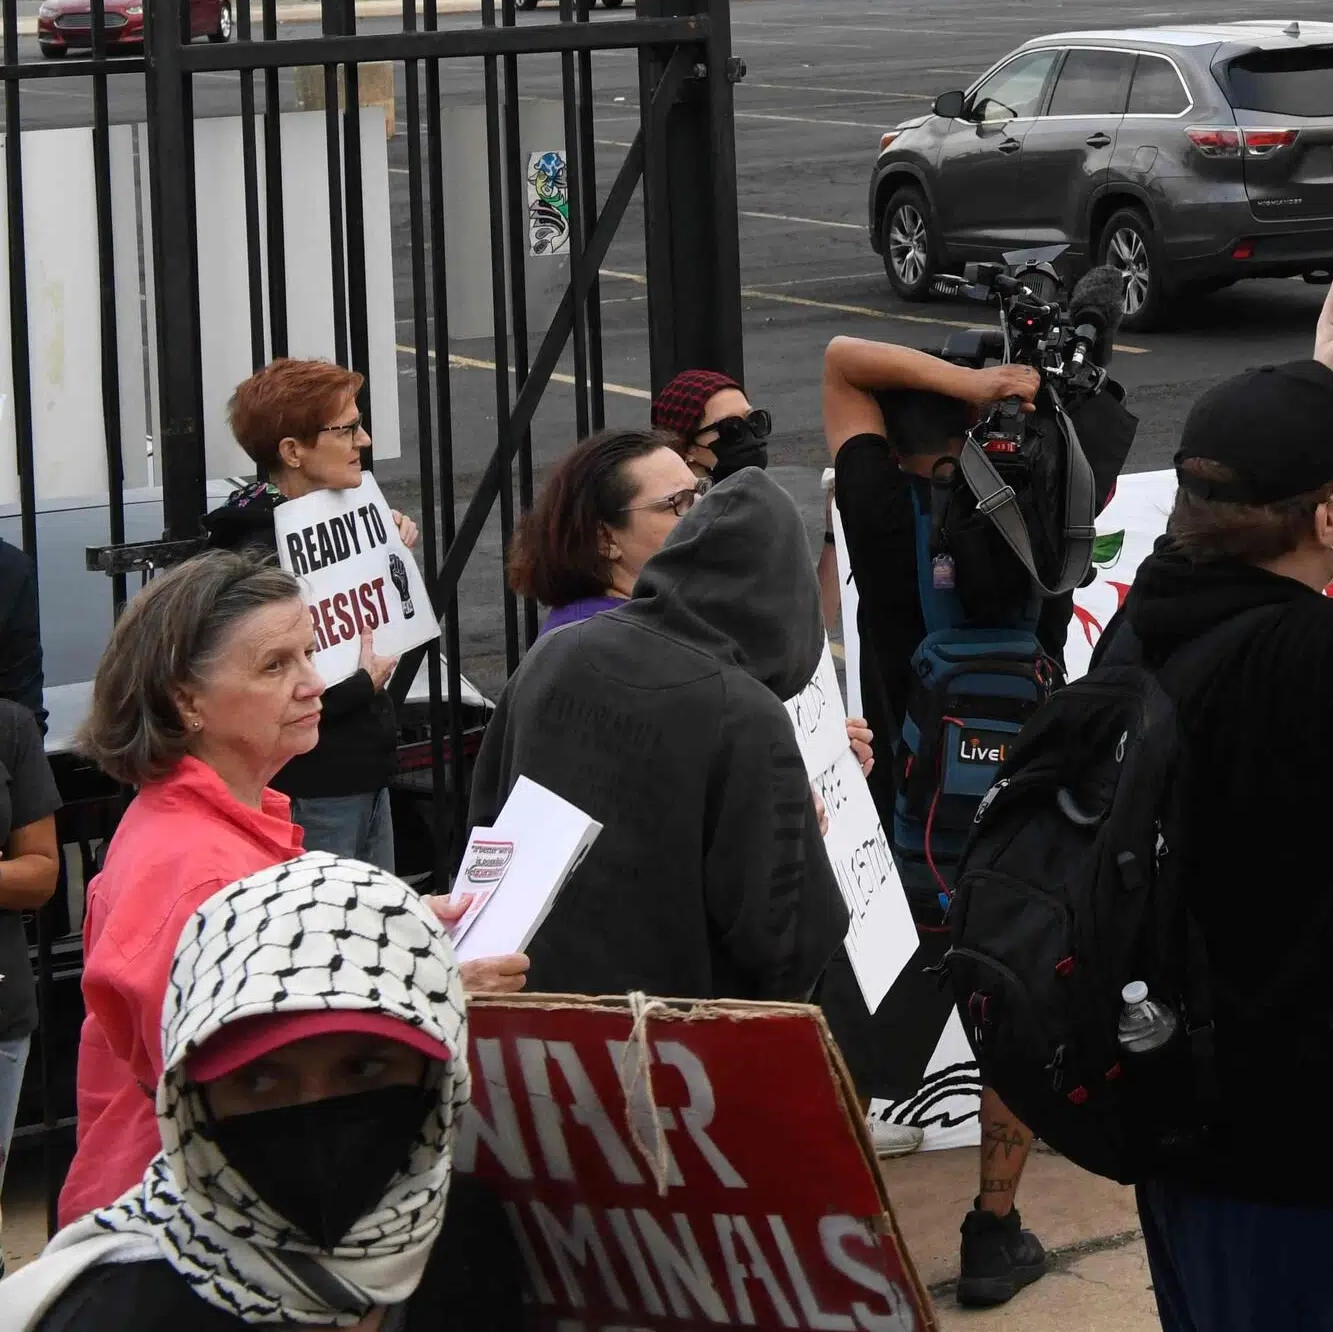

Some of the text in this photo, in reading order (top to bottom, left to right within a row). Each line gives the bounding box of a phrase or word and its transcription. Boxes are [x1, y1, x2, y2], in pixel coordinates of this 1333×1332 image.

[286, 502, 388, 578] READY TO
[308, 576, 390, 654] RESIST
[502, 1199, 915, 1332] IMINALS
